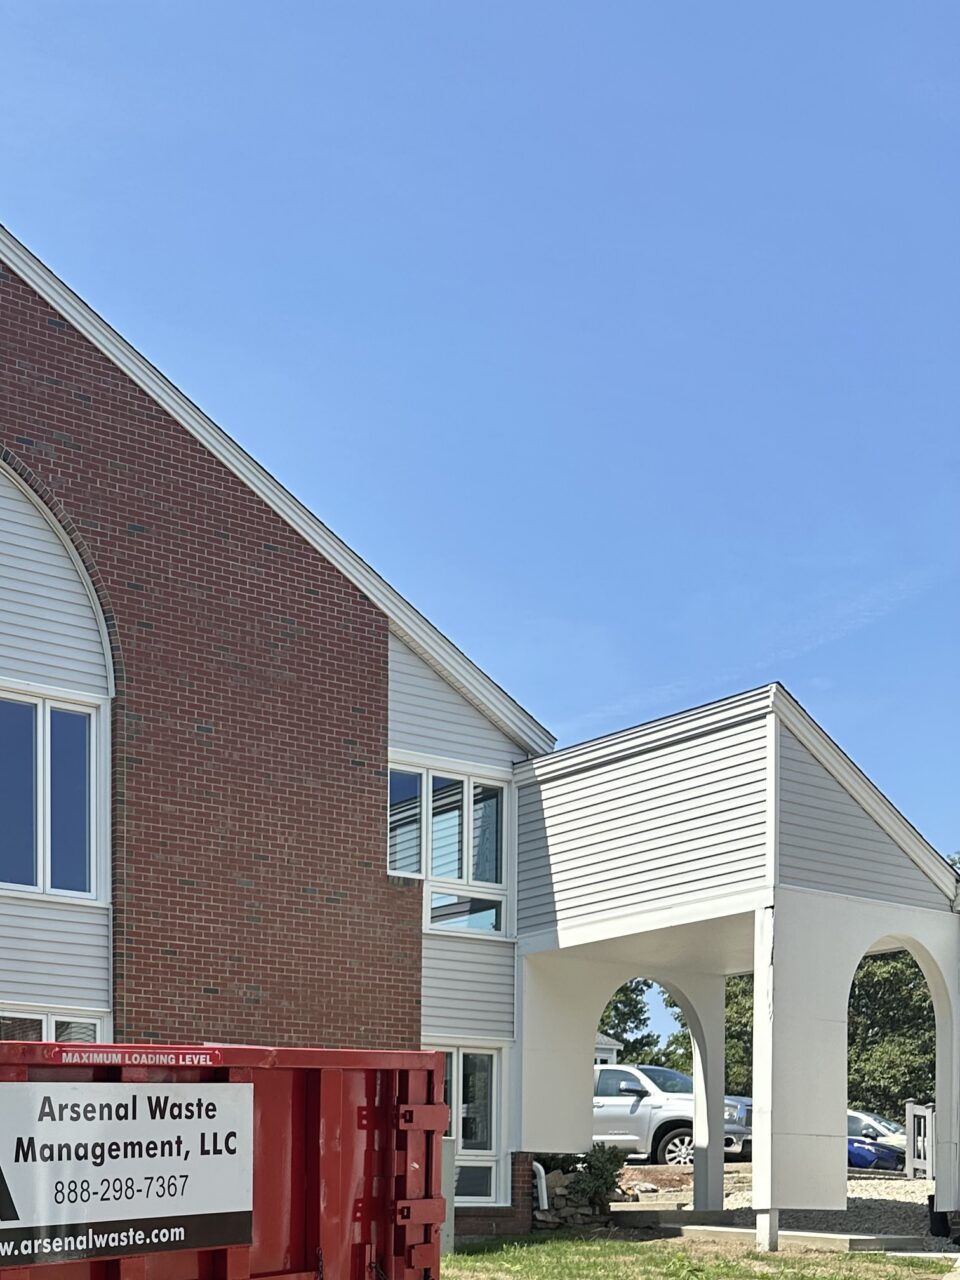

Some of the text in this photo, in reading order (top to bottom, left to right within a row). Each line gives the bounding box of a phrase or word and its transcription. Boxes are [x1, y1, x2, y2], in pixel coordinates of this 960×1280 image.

[62, 1052, 213, 1065] MAXIMUM LOADING LEVEL
[37, 1094, 217, 1122] Arsenal Waste
[14, 1131, 237, 1167] Management, LLC
[54, 1174, 189, 1205] 888-298-7367
